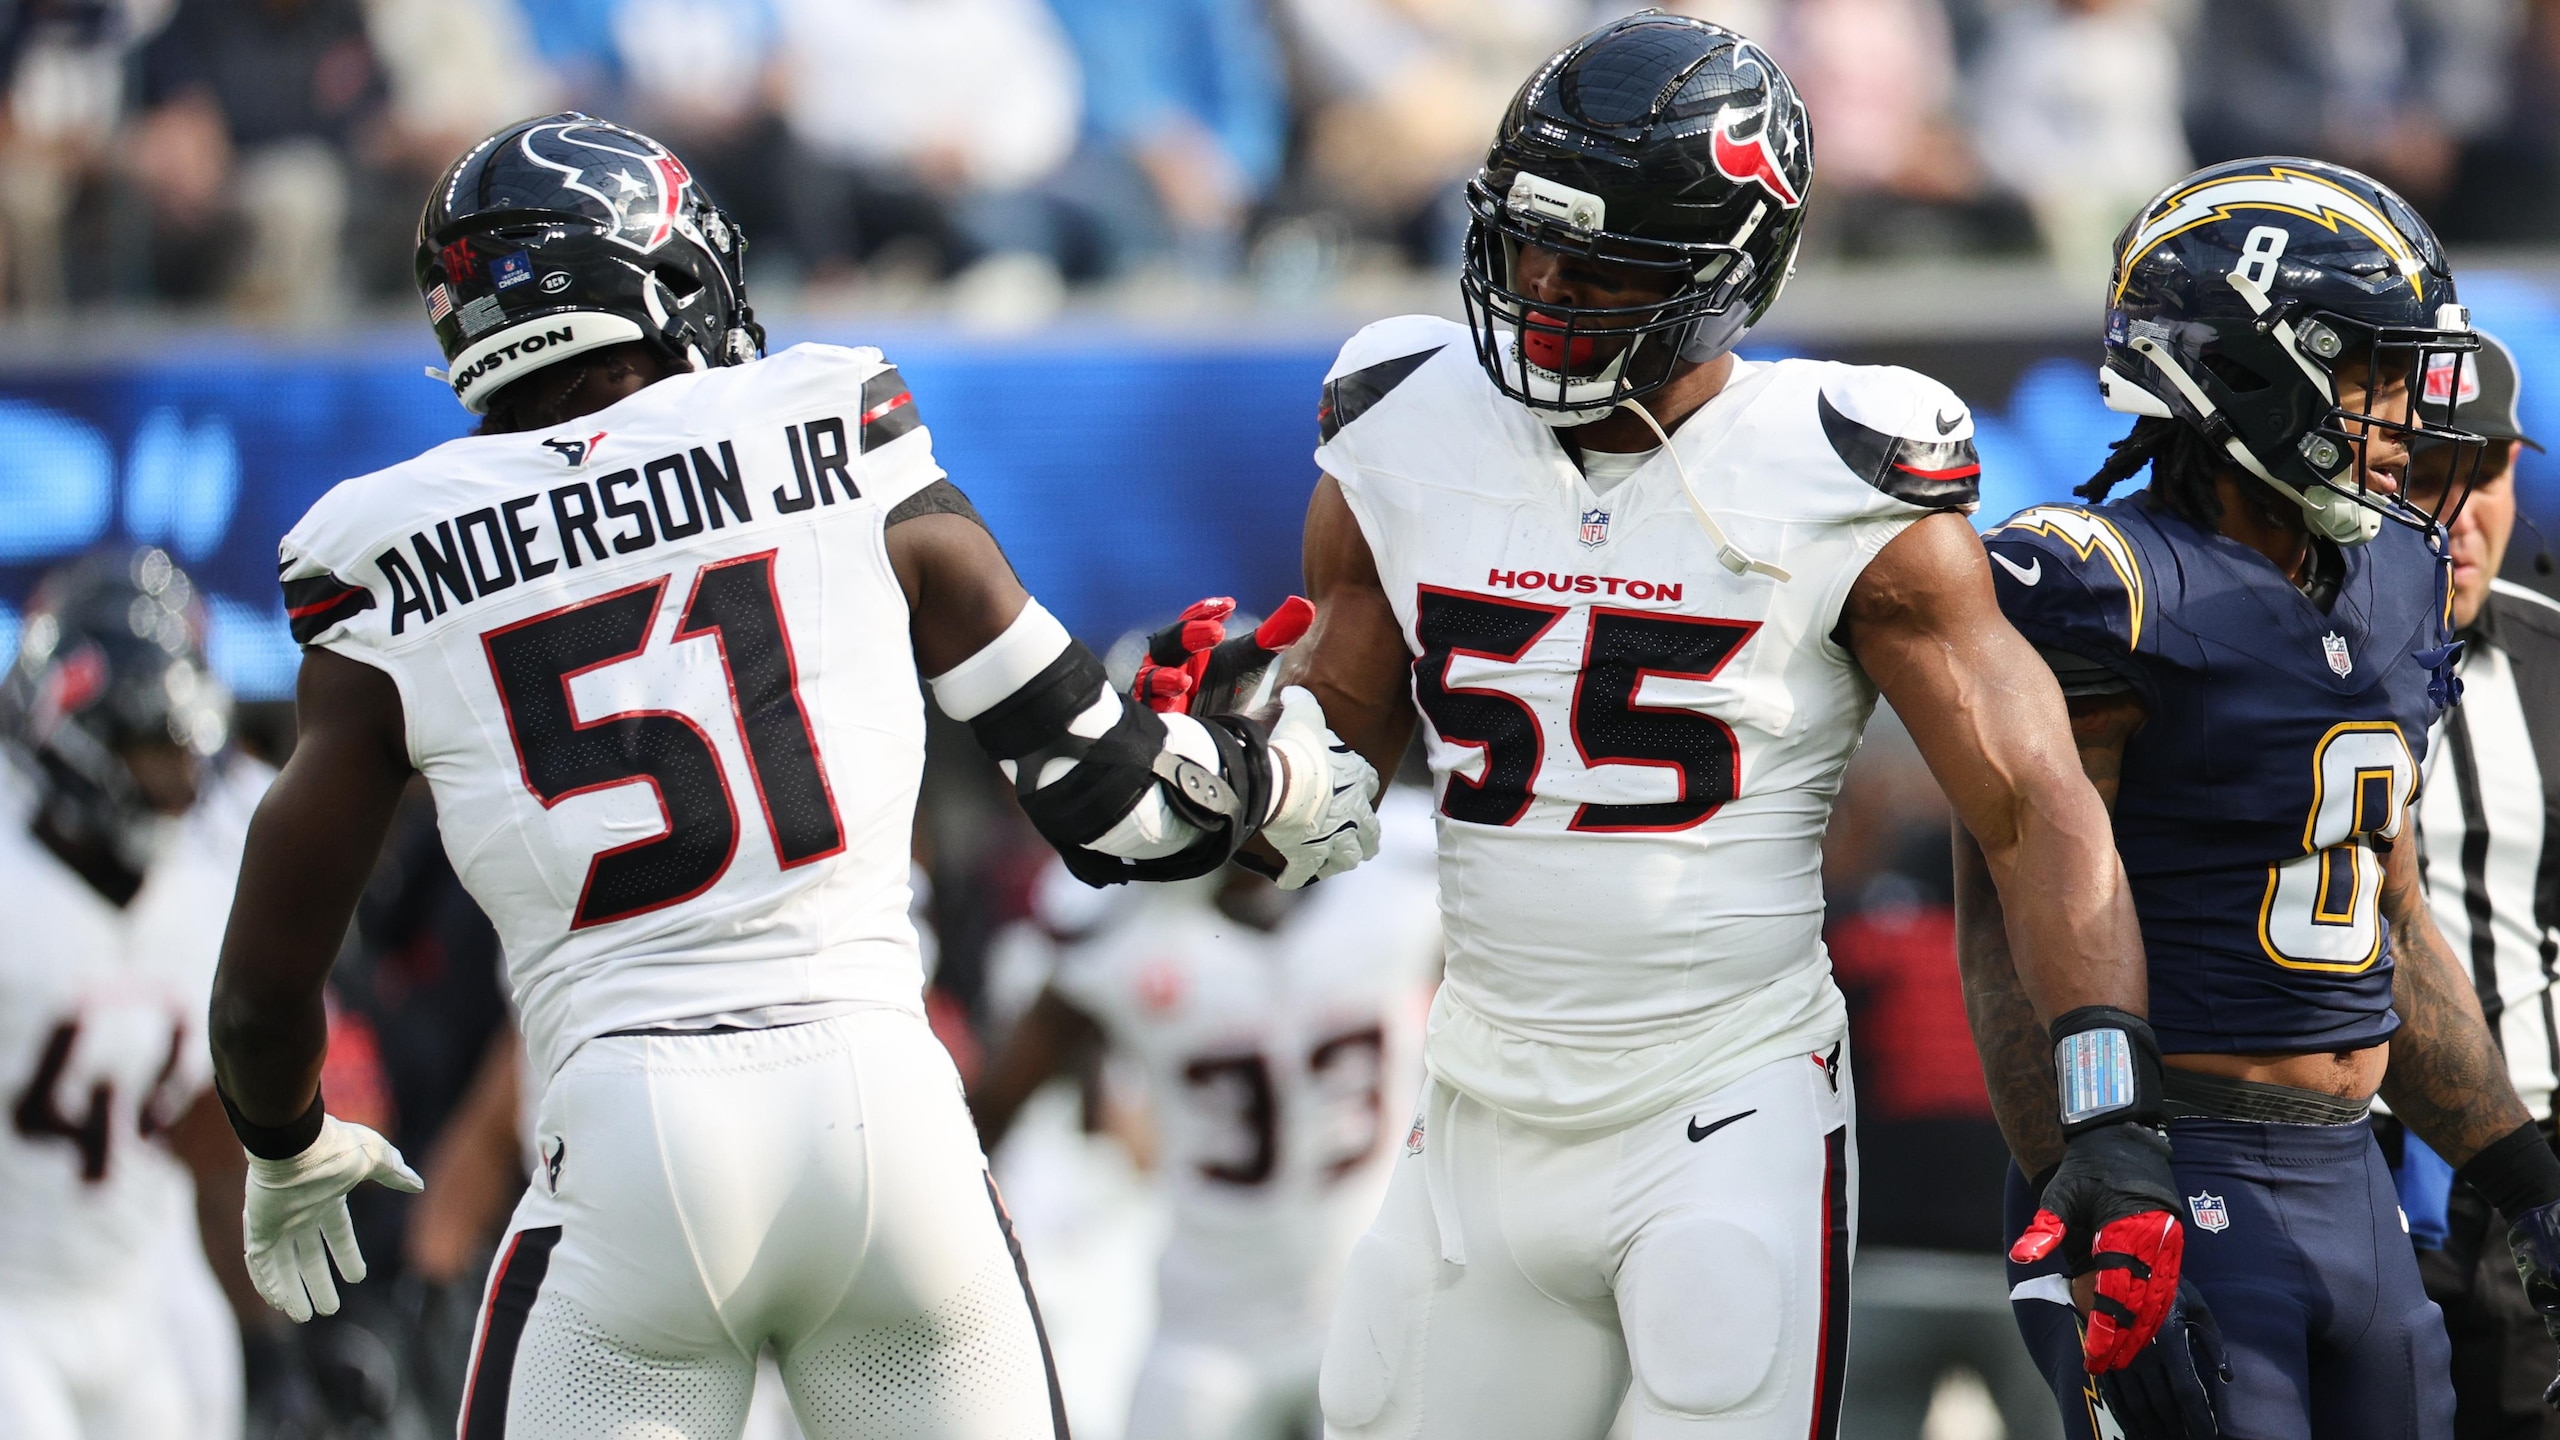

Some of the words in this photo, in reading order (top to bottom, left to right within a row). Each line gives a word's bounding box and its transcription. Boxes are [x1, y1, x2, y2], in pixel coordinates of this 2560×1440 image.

[1534, 193, 1569, 208] TEXANS
[2234, 225, 2289, 294] 8
[452, 326, 574, 398] HOUSTON
[375, 439, 753, 636] ANDERSON
[772, 416, 862, 515] JR
[1581, 524, 1605, 542] NFL
[1488, 568, 1683, 601] HOUSTON
[479, 547, 847, 931] 51
[1410, 582, 1764, 832] 55
[2258, 721, 2419, 974] 8
[2198, 1210, 2225, 1226] NFL
